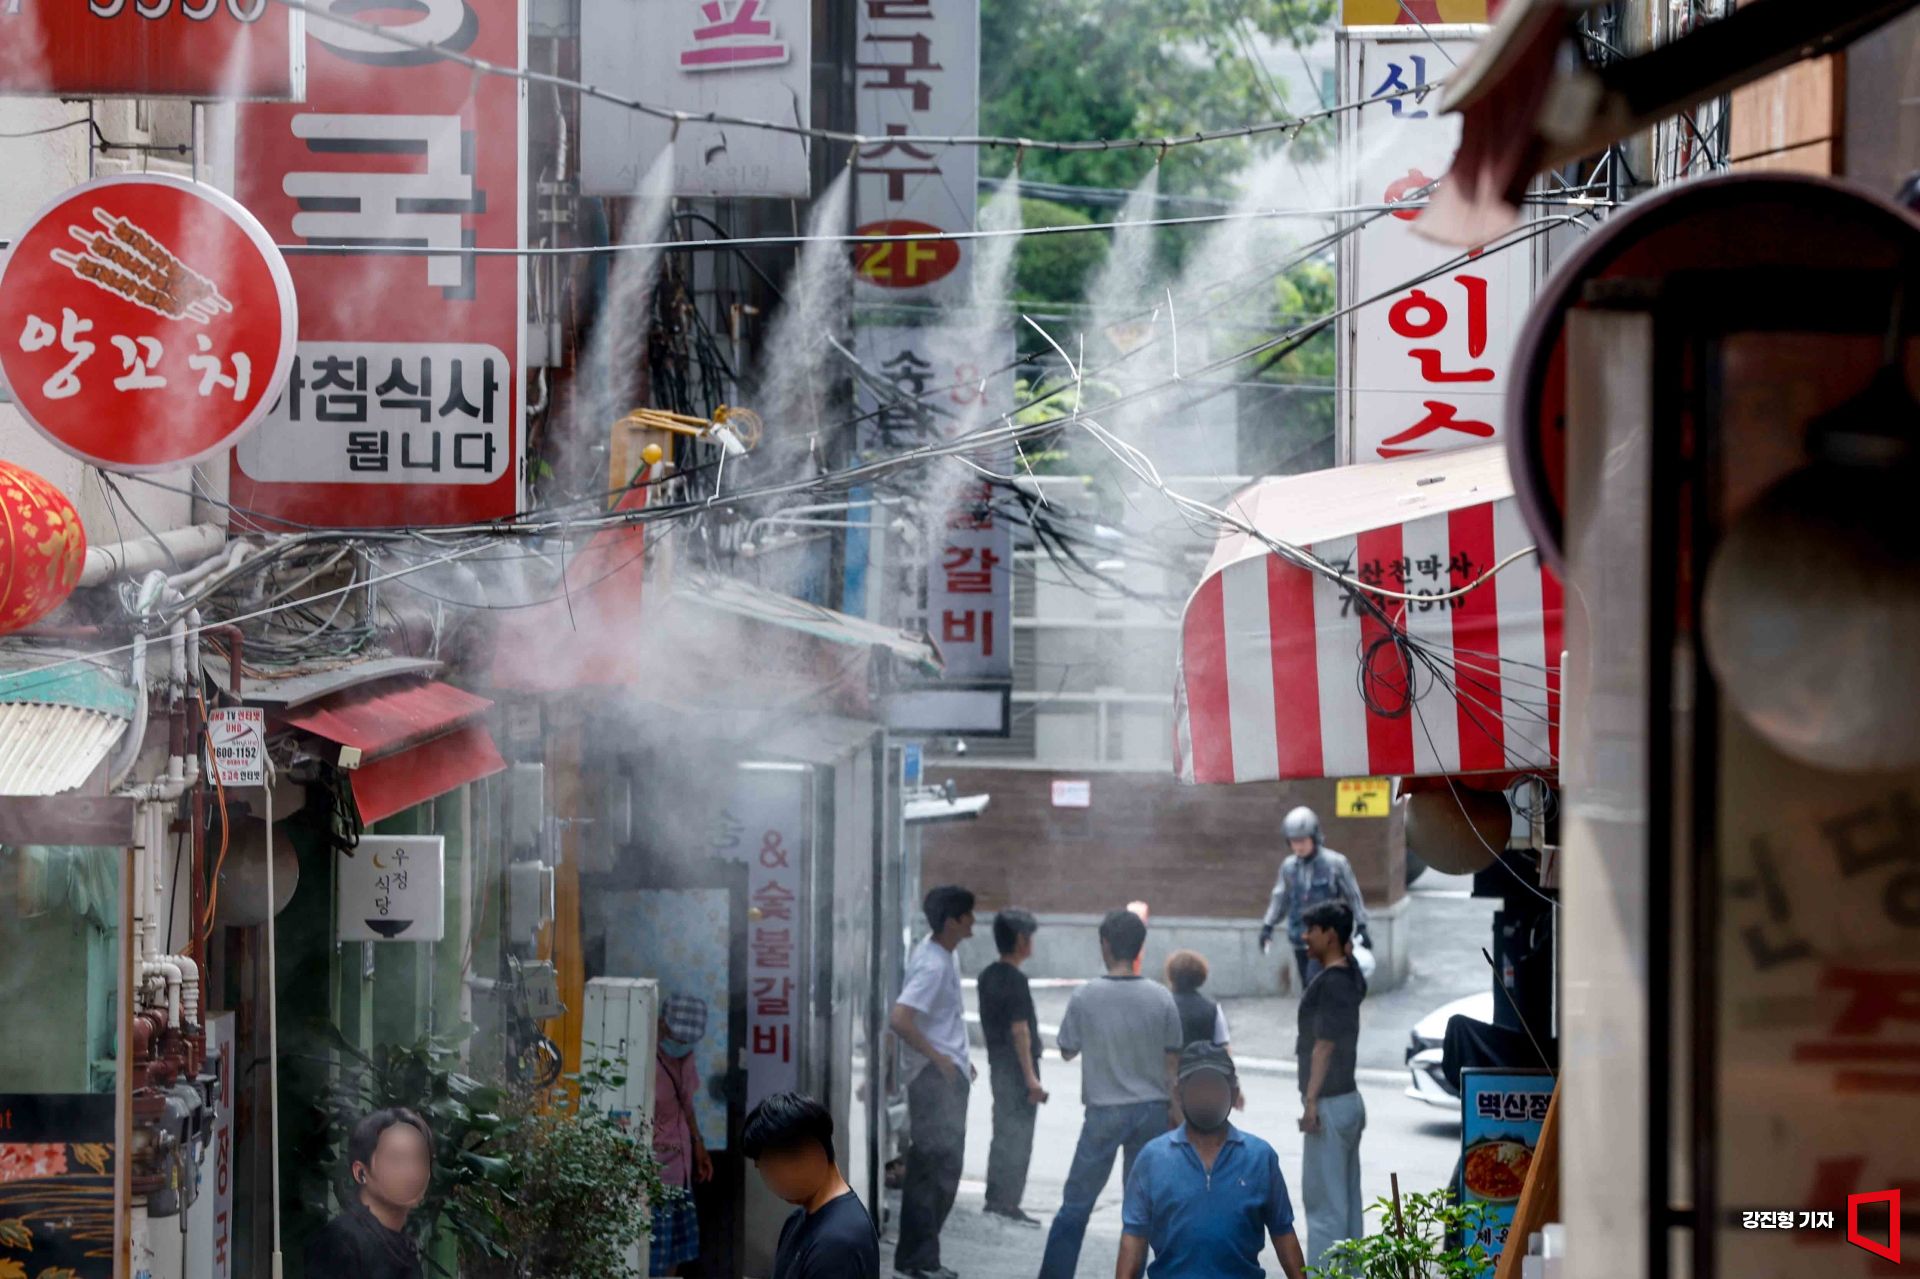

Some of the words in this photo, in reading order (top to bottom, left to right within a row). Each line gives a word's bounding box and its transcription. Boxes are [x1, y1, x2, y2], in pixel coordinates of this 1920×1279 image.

[859, 241, 940, 278] 2F
[19, 308, 251, 401] 양꼬치
[347, 431, 497, 472] 됩니다
[227, 711, 236, 721] TV
